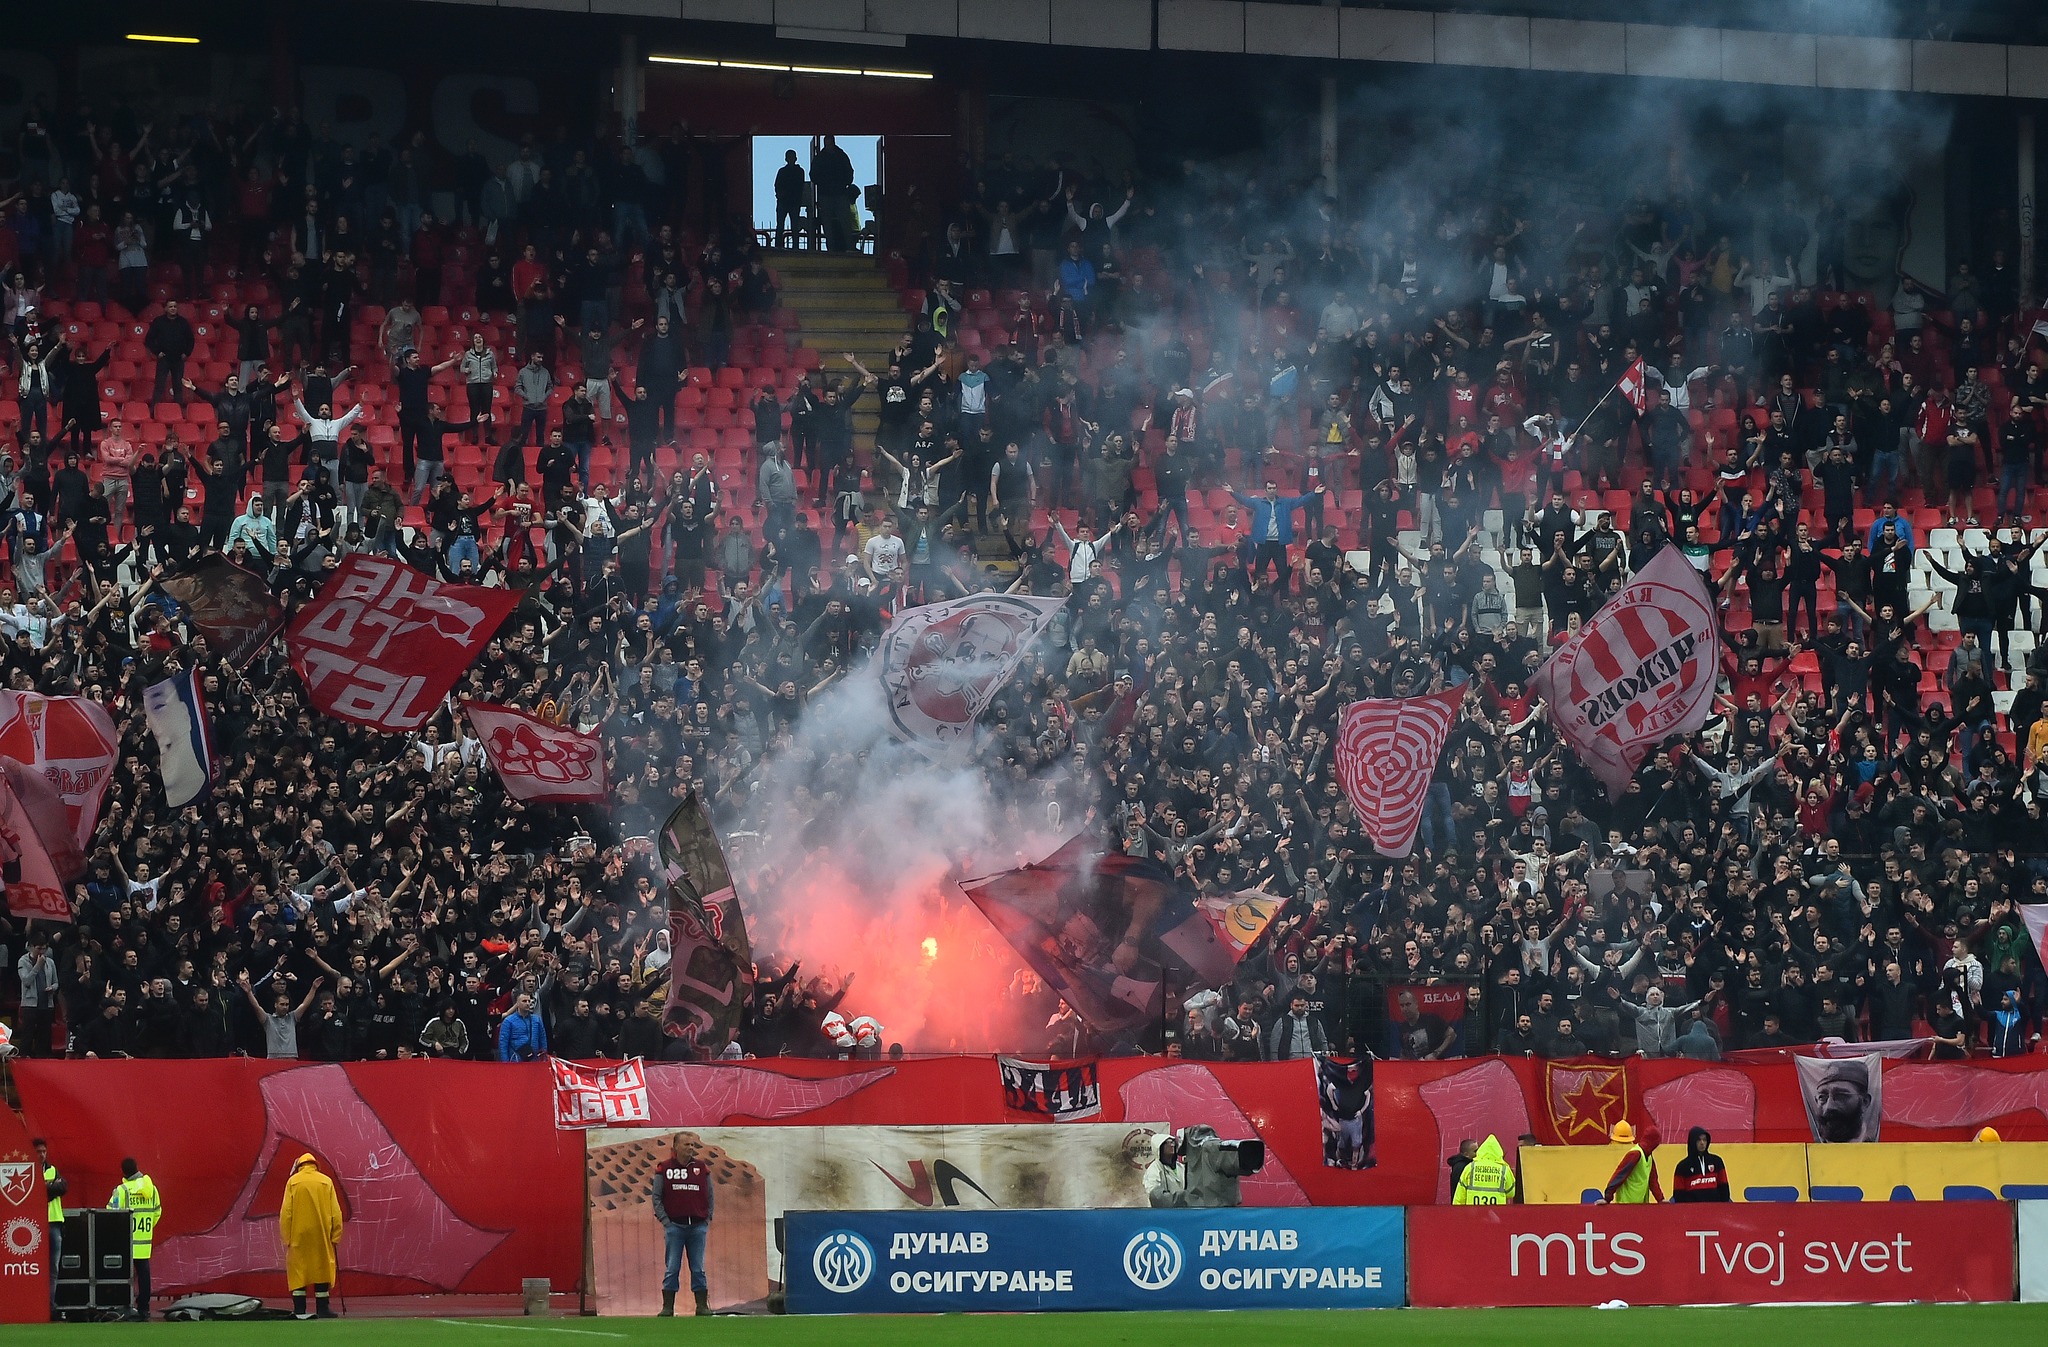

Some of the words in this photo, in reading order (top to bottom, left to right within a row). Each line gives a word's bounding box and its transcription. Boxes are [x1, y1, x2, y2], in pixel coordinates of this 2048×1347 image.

[666, 1168, 688, 1179] 025
[1474, 1174, 1500, 1183] SECURITY
[889, 1231, 989, 1260] ДУНАВ
[1199, 1228, 1298, 1257] ДУНАВ
[1510, 1221, 1646, 1276] mts
[1685, 1230, 1785, 1286] Tvoj
[1803, 1232, 1913, 1274] svet
[4, 1260, 40, 1275] mts
[1199, 1266, 1382, 1290] ОСИГУРАЊЕ
[889, 1269, 1073, 1293] ОСИГУРАЊЕ
